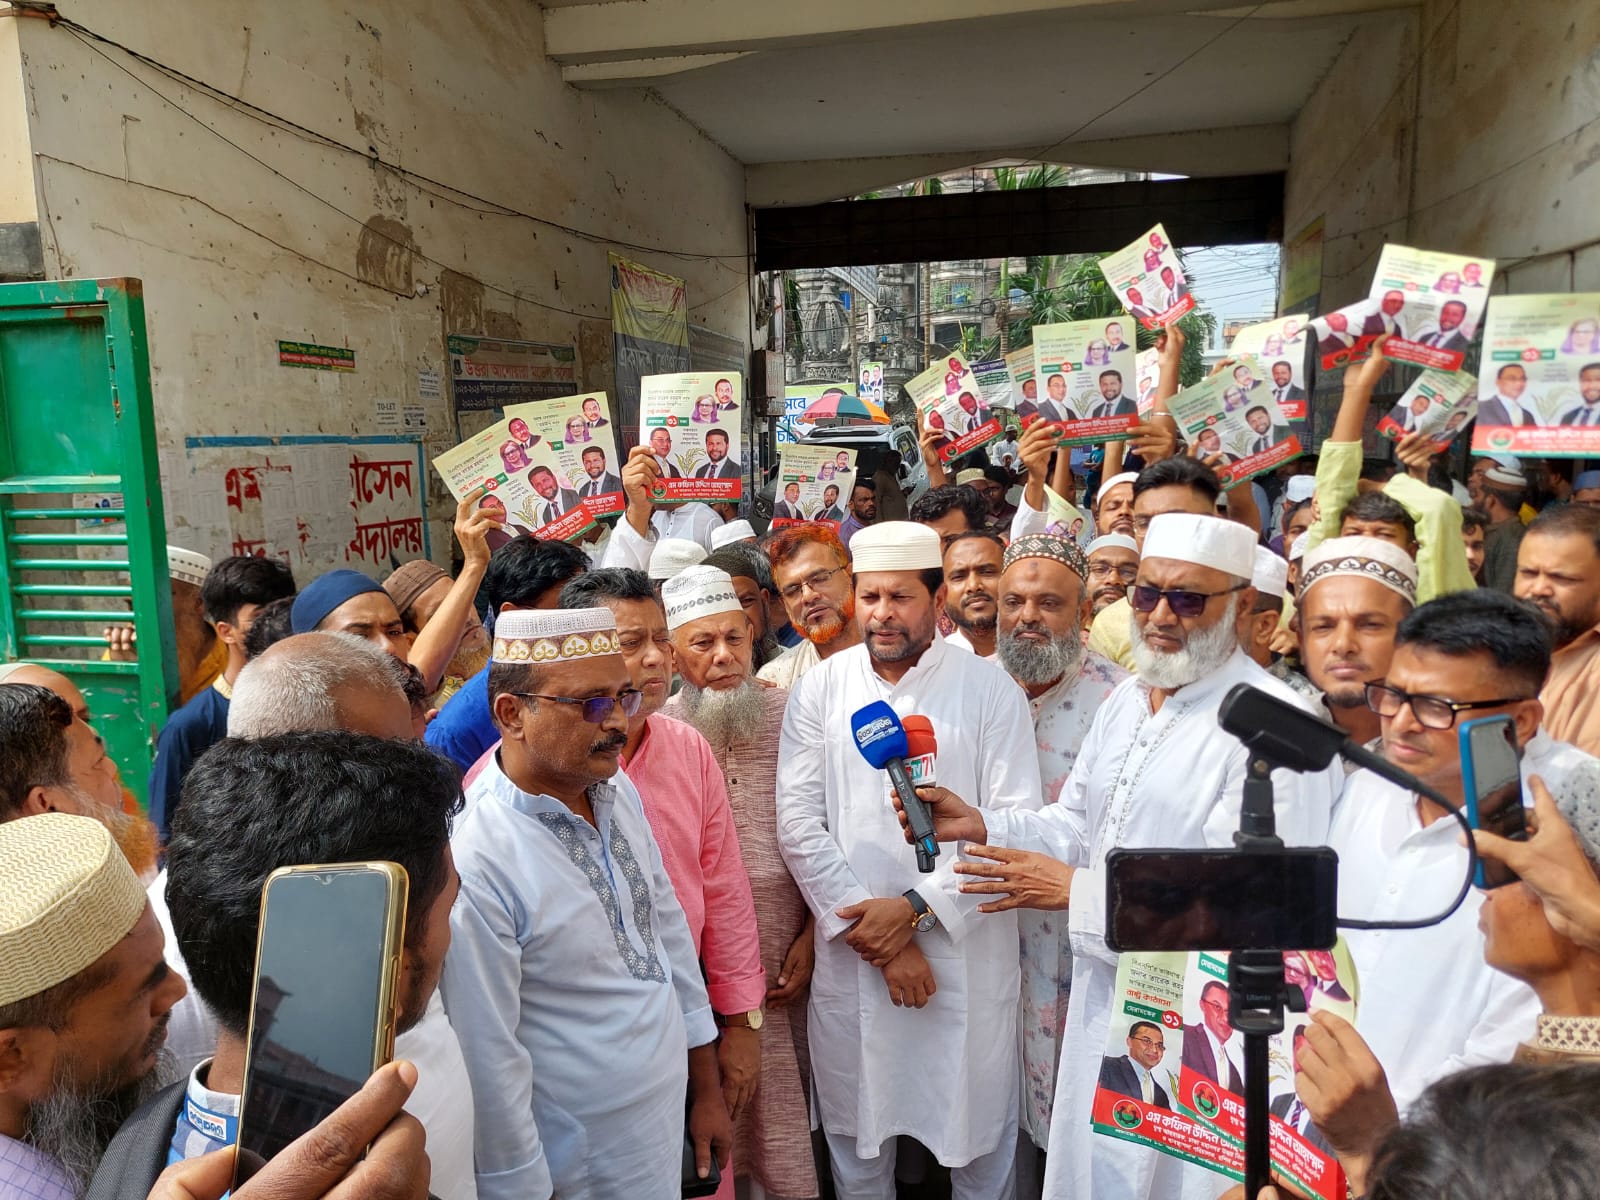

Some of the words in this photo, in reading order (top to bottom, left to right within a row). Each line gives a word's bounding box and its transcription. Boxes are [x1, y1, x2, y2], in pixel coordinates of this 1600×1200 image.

[487, 480, 497, 489] ৩১
[1143, 993, 1172, 1007] কাঠামো
[1163, 1014, 1180, 1027] ৩১
[1222, 1099, 1238, 1114] এম
[1146, 1111, 1161, 1121] এম
[1162, 1115, 1192, 1135] কফিল
[1192, 1123, 1219, 1145] উদ্দিন
